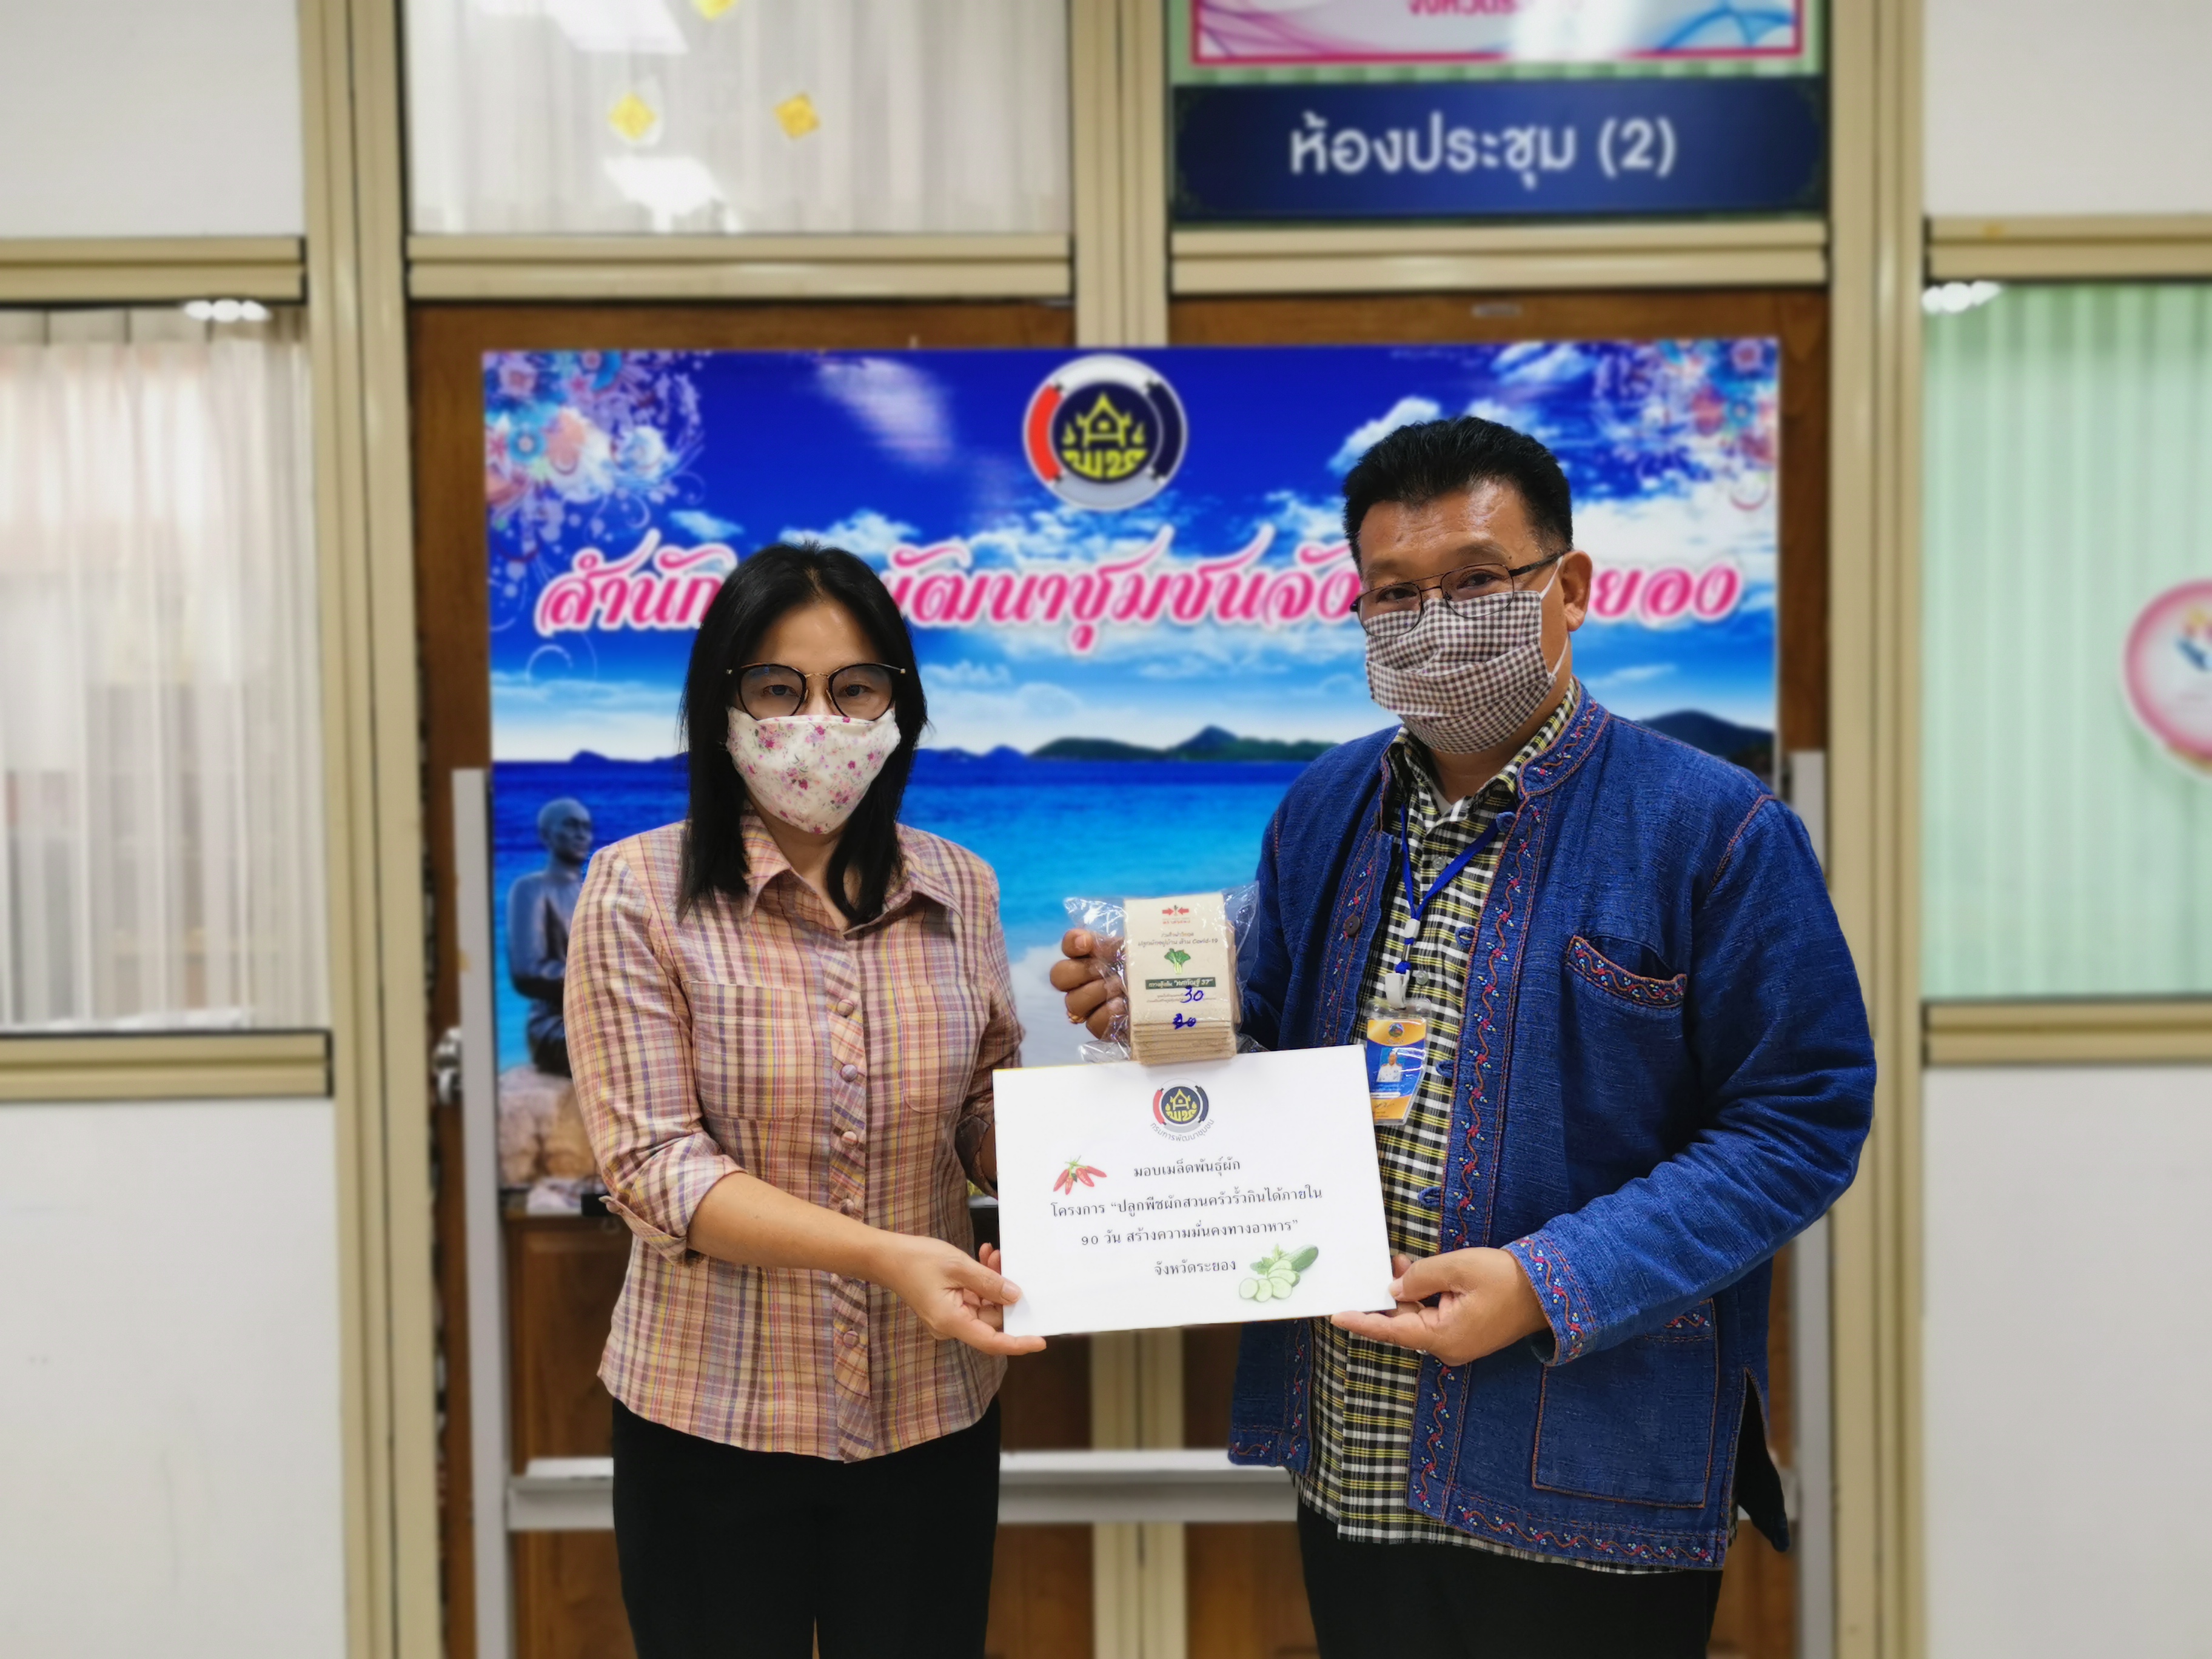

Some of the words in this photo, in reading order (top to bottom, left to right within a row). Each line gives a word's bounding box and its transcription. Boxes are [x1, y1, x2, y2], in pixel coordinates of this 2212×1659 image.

[1290, 112, 1577, 189] ห้องประชุม
[1597, 117, 1677, 178] (2)
[1180, 985, 1204, 1004] 30
[1150, 1119, 1215, 1142] กรมการพัฒนาชุมชน
[1133, 1156, 1241, 1178] มอบเมล็ดพันธุ์ผัก
[1050, 1202, 1106, 1218] โครงการ
[1081, 1235, 1099, 1246] 90
[1104, 1229, 1122, 1244] วัน
[1127, 1219, 1298, 1242] สร้างความมั่นคงทางอาหาร”
[1154, 1259, 1237, 1276] จังหวัดระยอง
